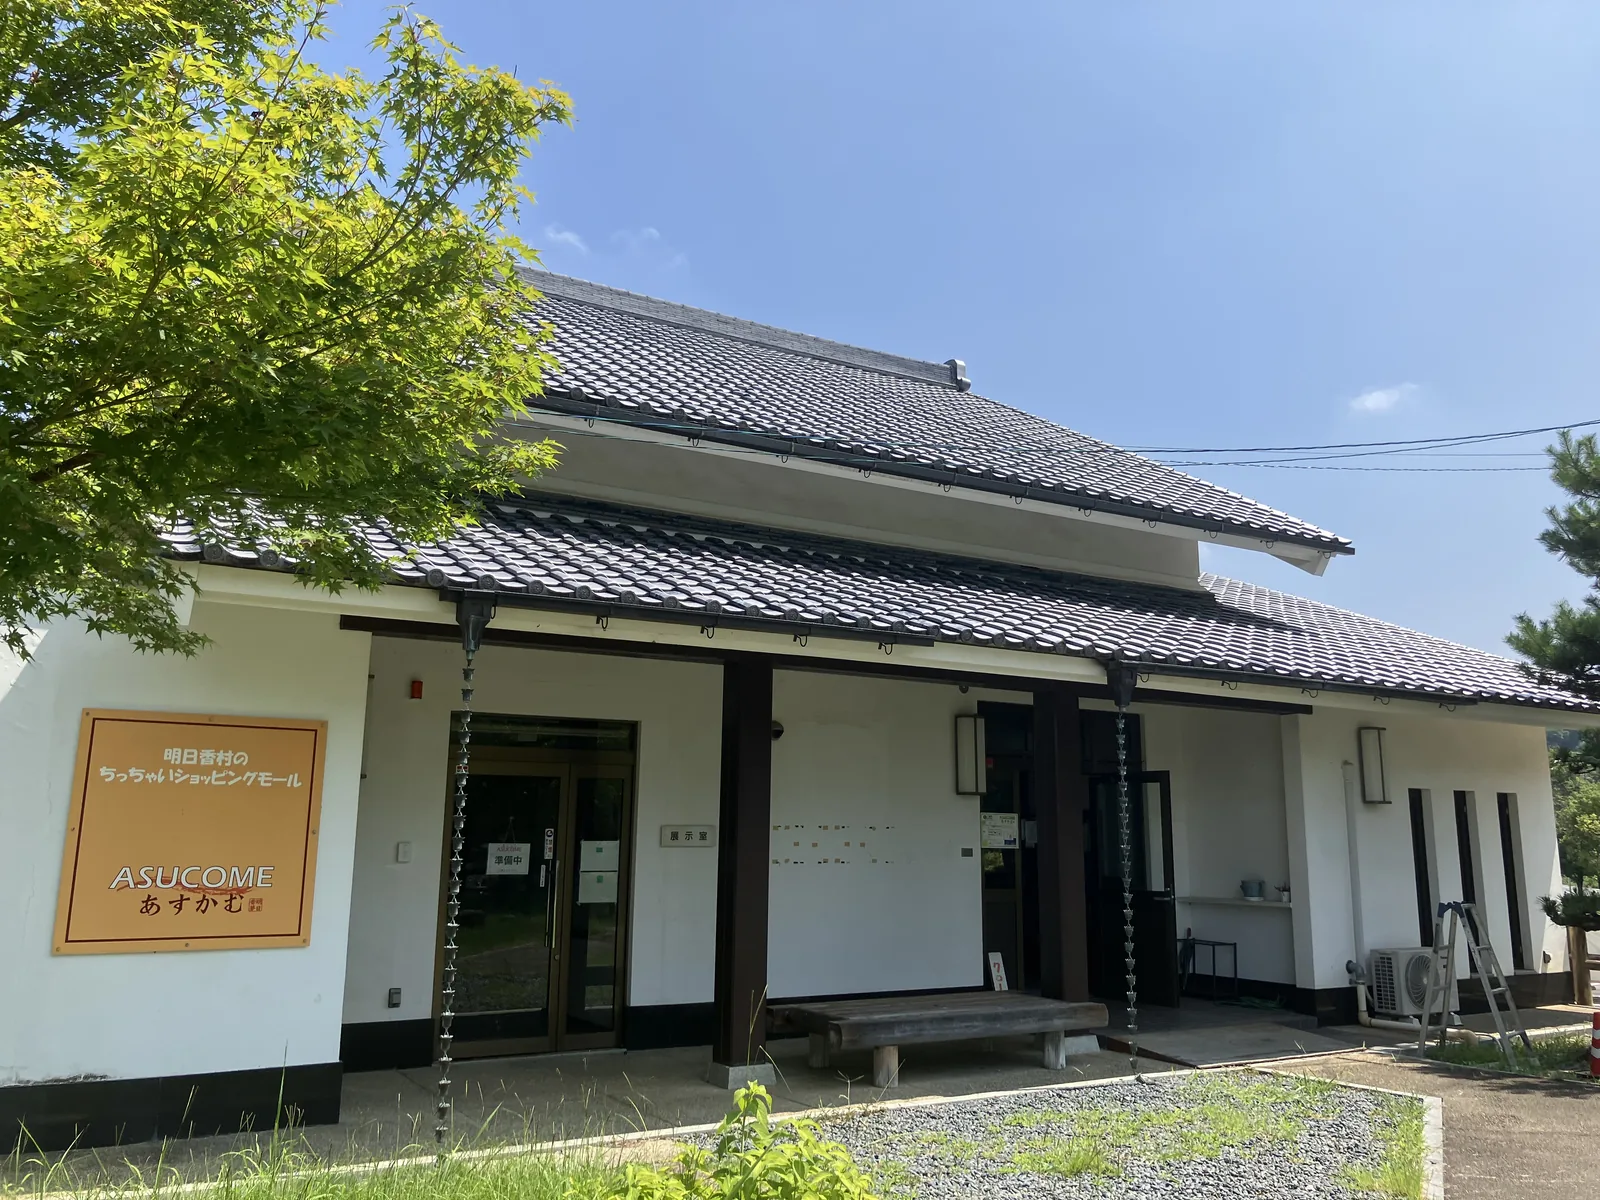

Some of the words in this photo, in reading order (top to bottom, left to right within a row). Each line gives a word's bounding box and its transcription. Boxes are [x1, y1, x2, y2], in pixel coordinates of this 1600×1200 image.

[164, 748, 249, 766] 明日香村の
[99, 766, 302, 788] ちっちゃいショッピングモール
[670, 831, 708, 841] 展示室
[494, 855, 523, 866] 準備中
[108, 866, 275, 889] ASUCOME
[139, 893, 245, 916] あすかむ
